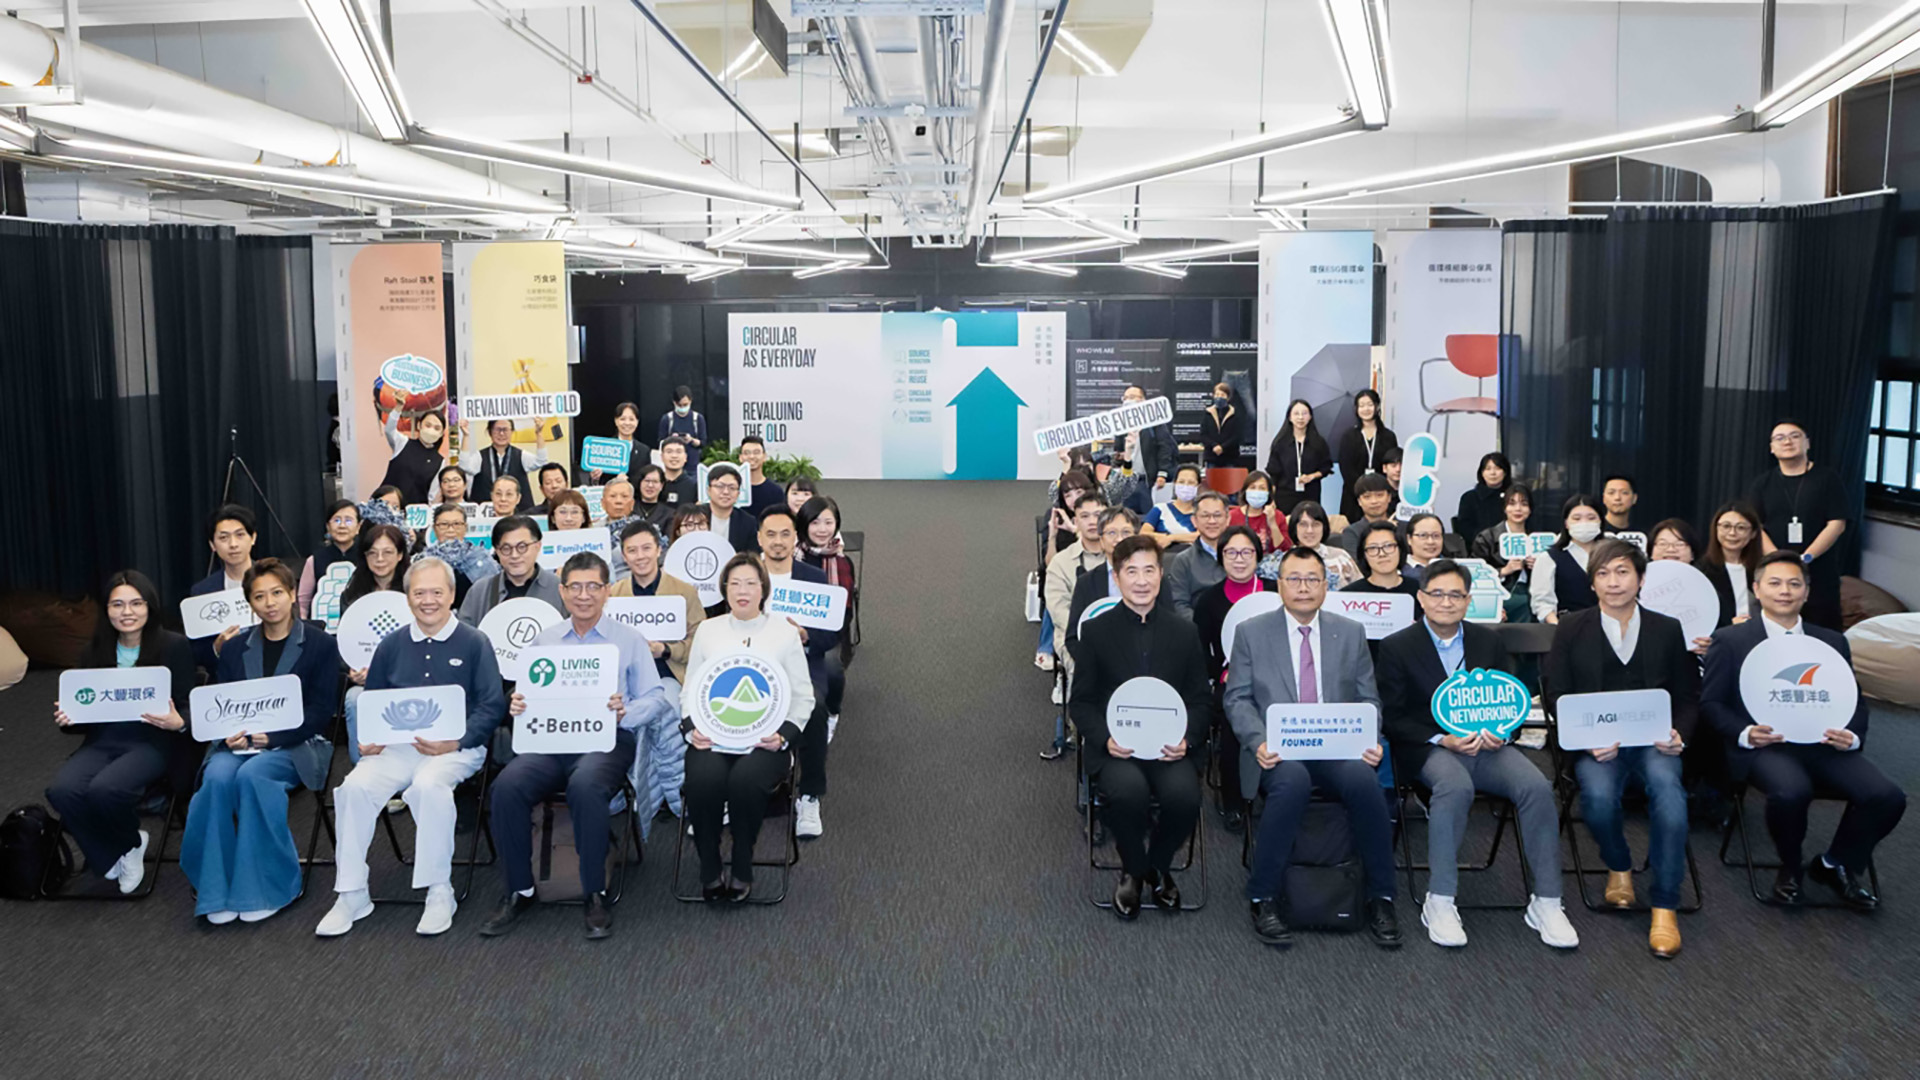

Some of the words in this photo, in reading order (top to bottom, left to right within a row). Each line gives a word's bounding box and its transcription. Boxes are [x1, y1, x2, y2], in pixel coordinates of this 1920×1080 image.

[743, 326, 797, 346] CIRCULAR
[1201, 342, 1238, 350] SUSTAINABLE
[743, 349, 757, 368] AS
[761, 349, 816, 368] EVERYDAY
[391, 369, 432, 387] BUSINESS
[466, 398, 529, 418] REVALUING
[532, 395, 552, 414] THE
[556, 394, 577, 413] OLD
[743, 402, 803, 421] REVALUING
[743, 424, 762, 438] THE
[766, 423, 787, 442] OLD
[1037, 419, 1094, 452] CIRCULAR
[1095, 415, 1112, 437] AS
[1111, 399, 1169, 432] EVERYDAY
[590, 445, 621, 457] SOURCE
[406, 506, 427, 527] 物
[556, 542, 603, 553] FamilyMart
[771, 603, 828, 619] SIMBALION
[1342, 600, 1392, 616] YMCF
[562, 658, 600, 670] LIVING
[561, 671, 599, 679] FOUNTAIN
[100, 686, 156, 702] 大豐環保
[1448, 686, 1516, 706] CIRCULAR
[1769, 689, 1831, 703] 大振豐洋傘
[1449, 706, 1517, 724] NETWORKING
[1281, 738, 1323, 747] FOUNDER
